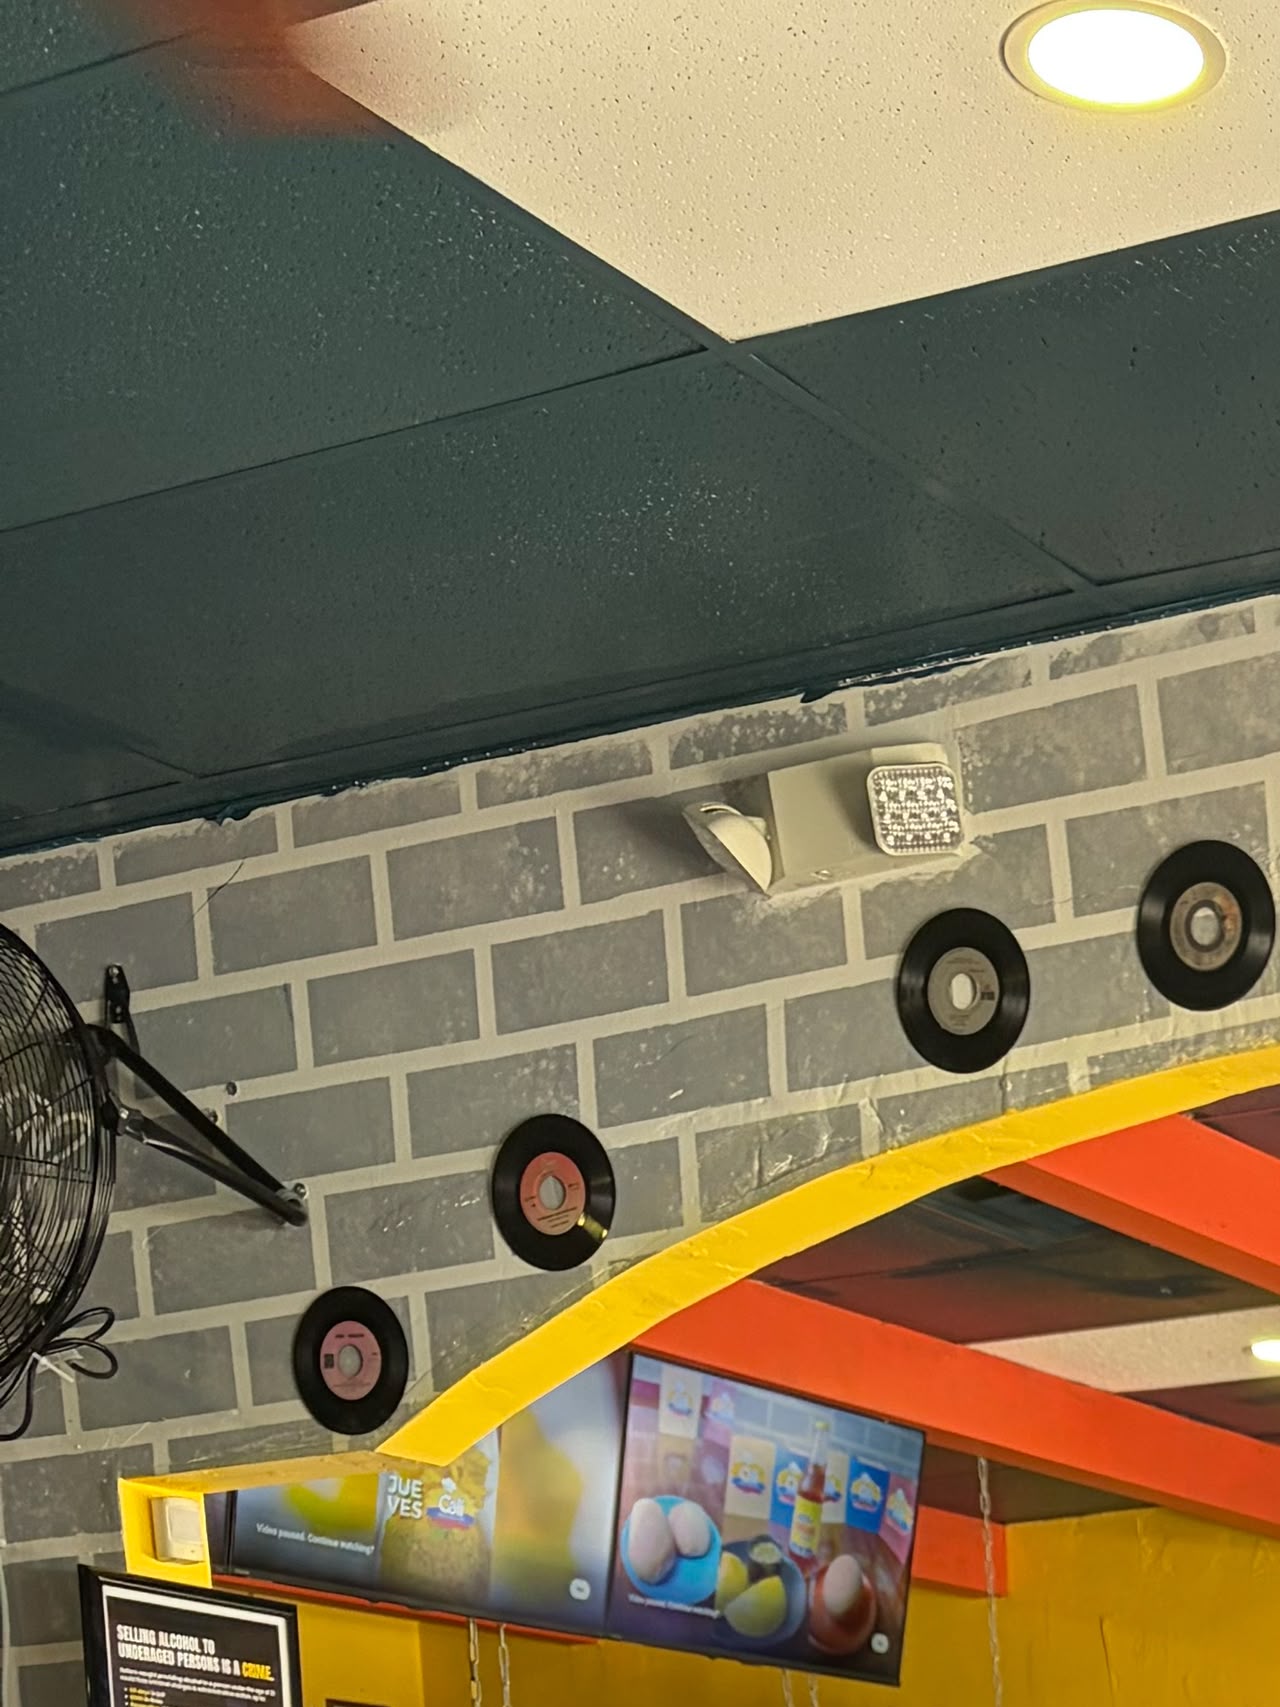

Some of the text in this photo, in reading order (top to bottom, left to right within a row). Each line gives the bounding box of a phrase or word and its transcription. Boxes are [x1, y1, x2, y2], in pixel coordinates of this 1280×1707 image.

[387, 1475, 423, 1498] JUE
[387, 1495, 423, 1519] VES
[116, 1624, 216, 1655] SELLING ALCOHOL TO
[118, 1642, 175, 1666] UNDERAGED
[177, 1652, 220, 1674] PERSONS
[221, 1658, 232, 1675] IS
[233, 1660, 241, 1677] A
[242, 1662, 275, 1682] CRIME.
